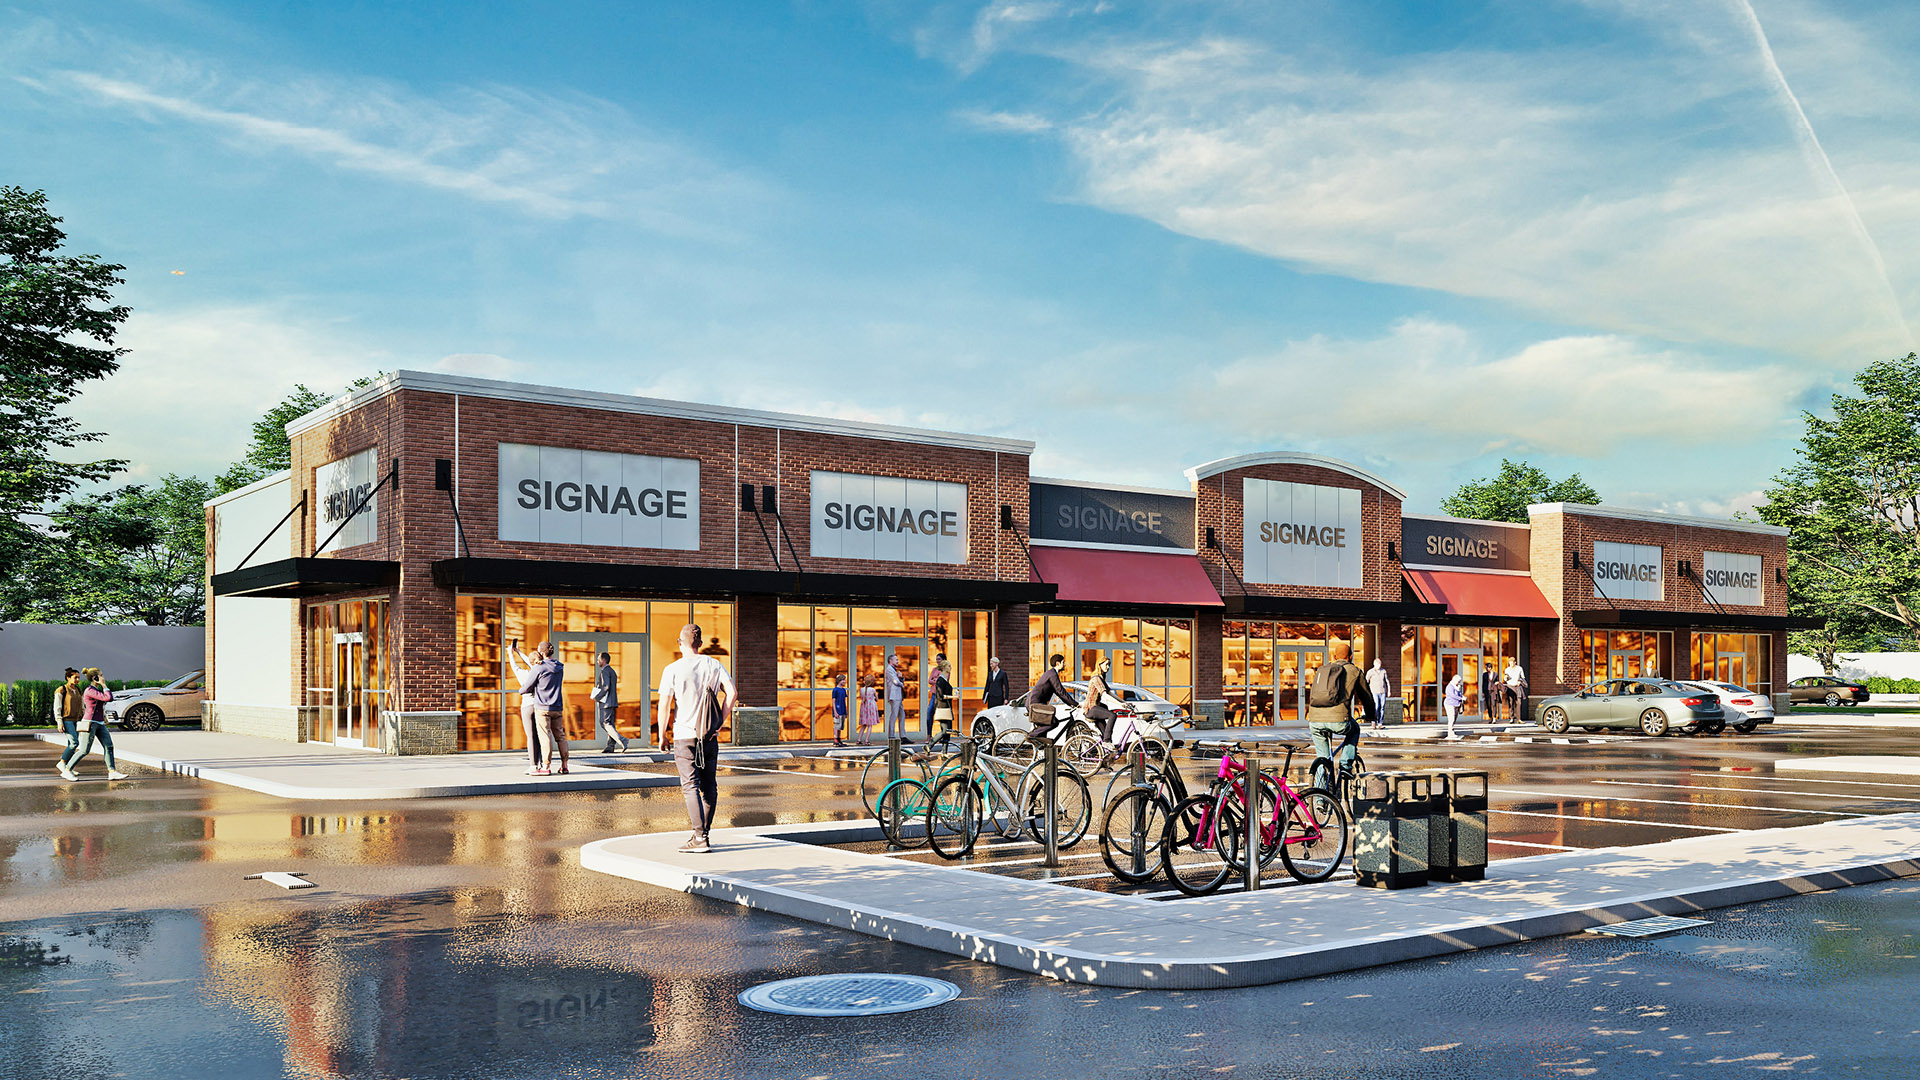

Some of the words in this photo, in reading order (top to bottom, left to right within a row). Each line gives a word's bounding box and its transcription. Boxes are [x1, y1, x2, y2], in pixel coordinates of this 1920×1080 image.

[517, 478, 688, 519] SIGNAGE
[824, 502, 958, 537] SIGNAGE
[1058, 504, 1162, 535] SIGNAGE
[1260, 521, 1346, 548] SIGNAGE
[1426, 535, 1498, 559] SIGNAGE
[1597, 561, 1657, 582] SIGNAGE
[1705, 569, 1758, 589] SIGNAGE
